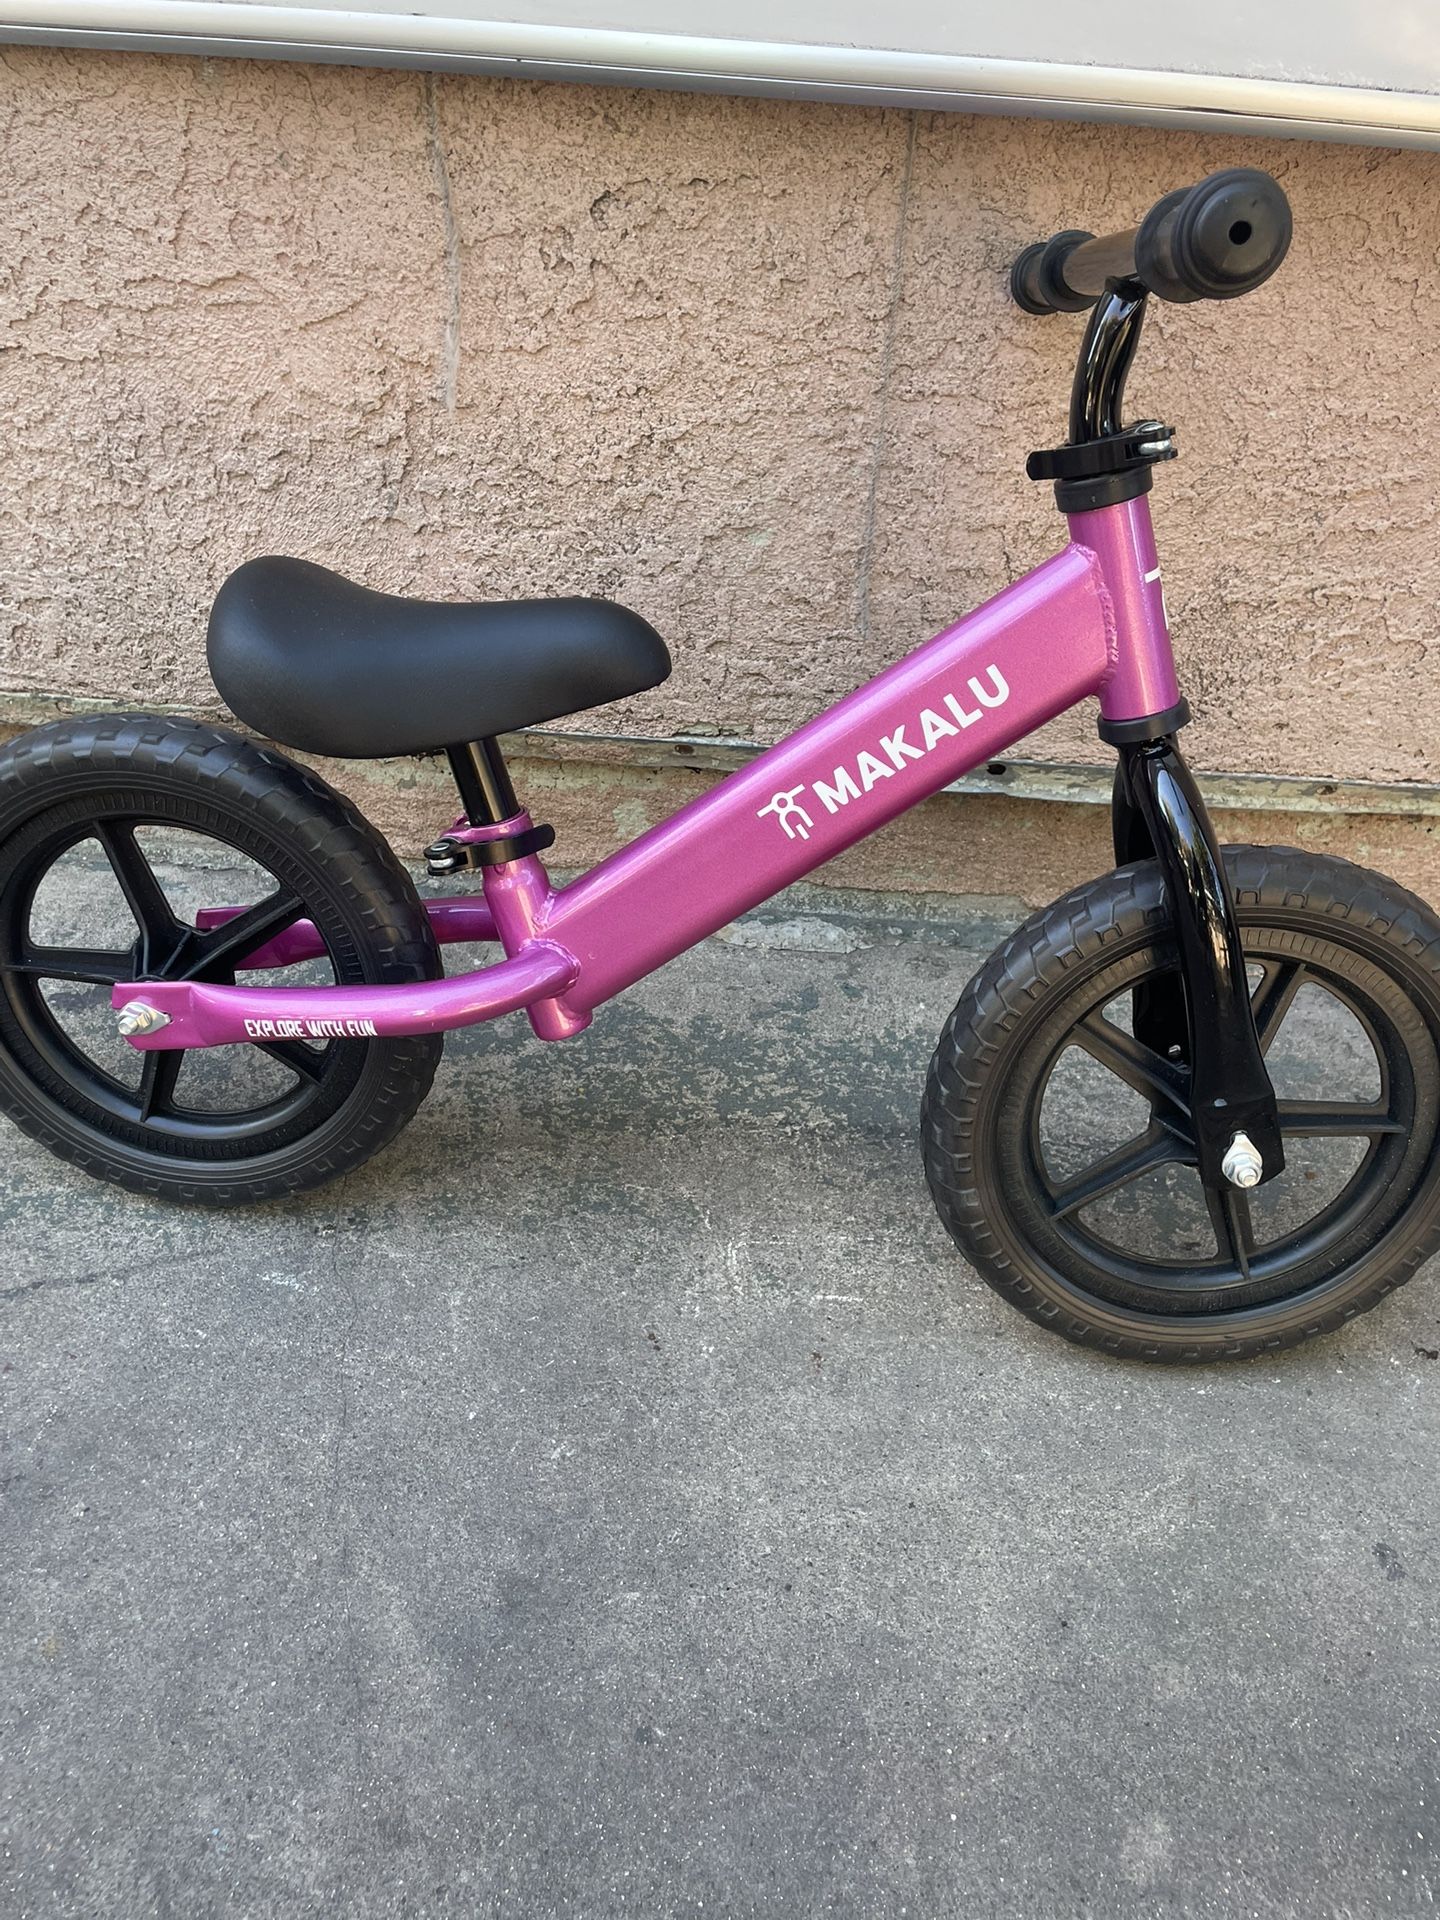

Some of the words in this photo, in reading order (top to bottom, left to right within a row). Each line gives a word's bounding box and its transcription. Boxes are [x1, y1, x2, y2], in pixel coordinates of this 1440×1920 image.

[812, 664, 1010, 814] MAKALU
[244, 1019, 307, 1037] EXPLORE
[306, 1020, 347, 1037] WITH
[346, 1020, 378, 1036] FUN
